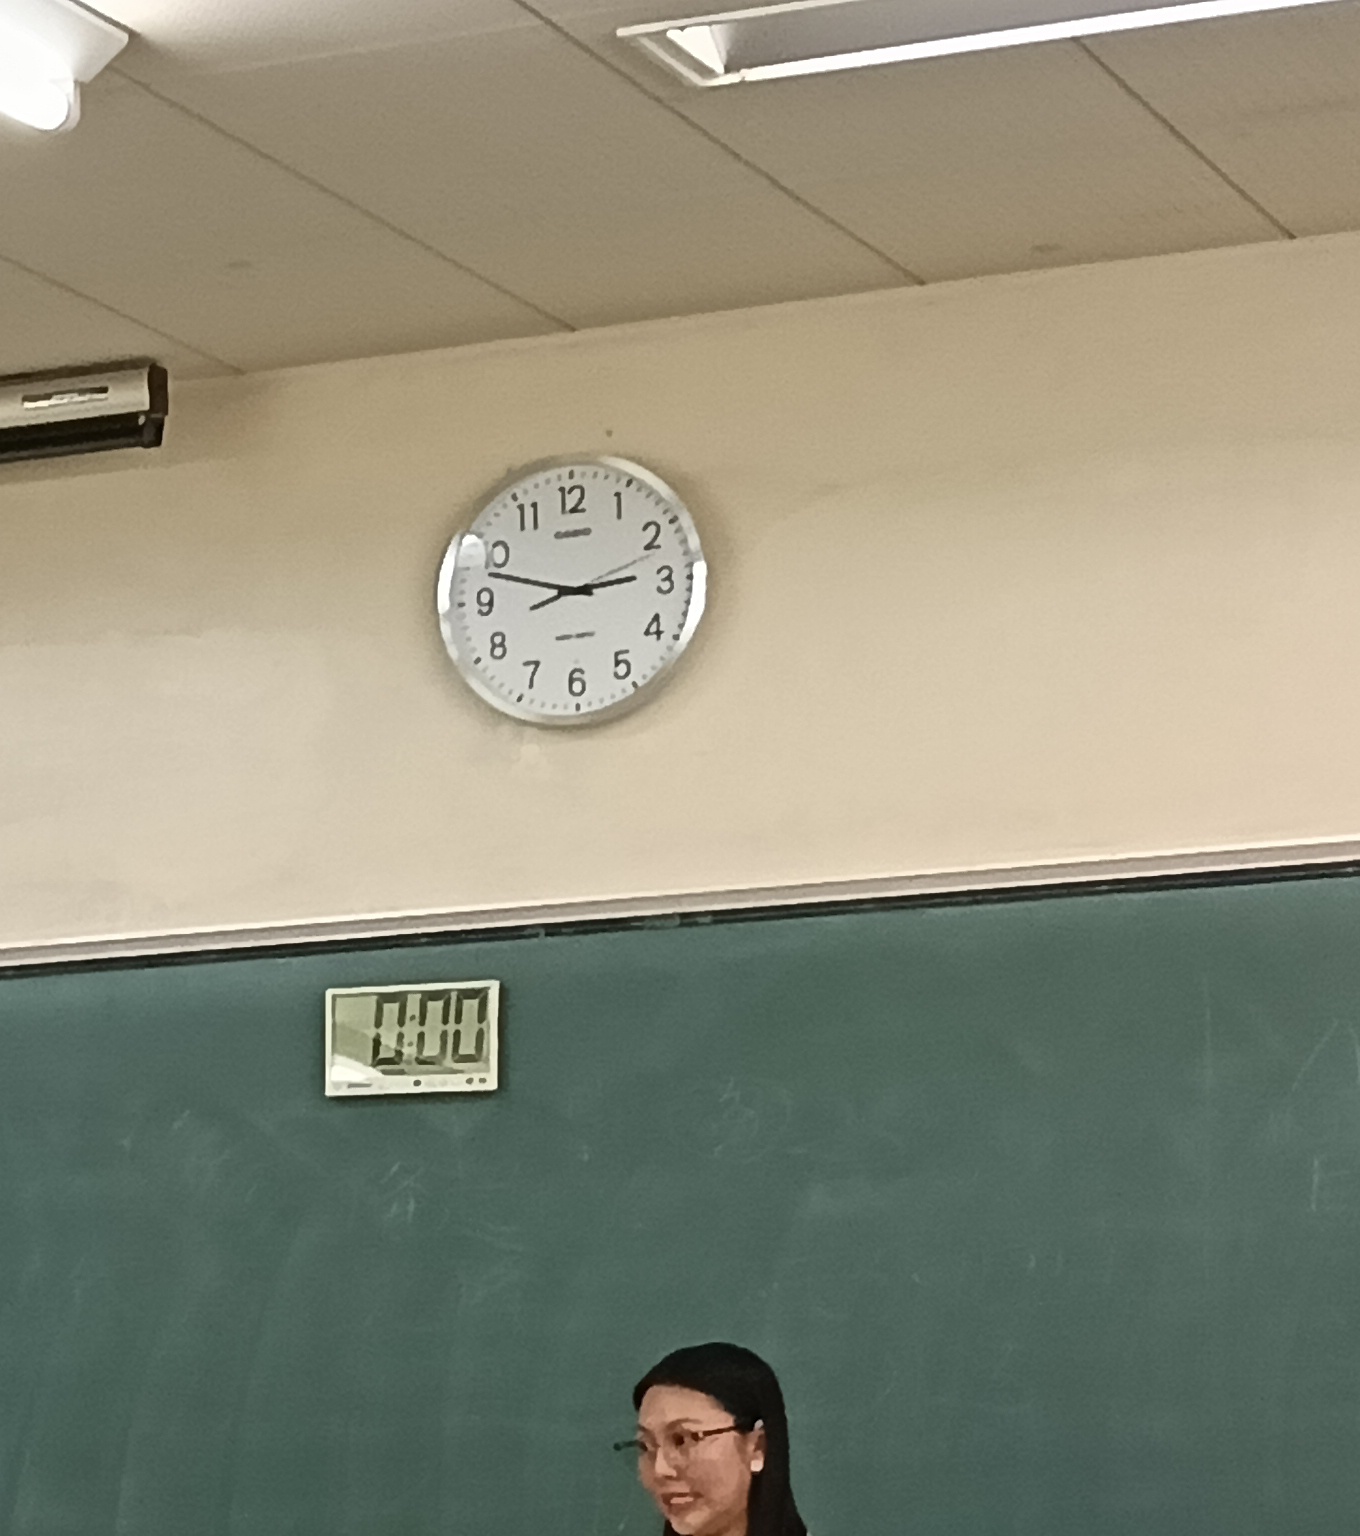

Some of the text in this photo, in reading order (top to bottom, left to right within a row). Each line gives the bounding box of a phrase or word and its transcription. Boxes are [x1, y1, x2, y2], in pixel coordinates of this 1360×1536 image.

[558, 484, 587, 515] 12
[613, 491, 623, 520] 1
[516, 502, 539, 531] 11
[642, 520, 661, 551] 2
[656, 565, 675, 595] 3
[476, 587, 495, 616] 9
[643, 613, 665, 641] 4
[489, 631, 507, 660] 8
[522, 660, 541, 690] 7
[613, 649, 632, 680] 5
[568, 667, 587, 697] 6
